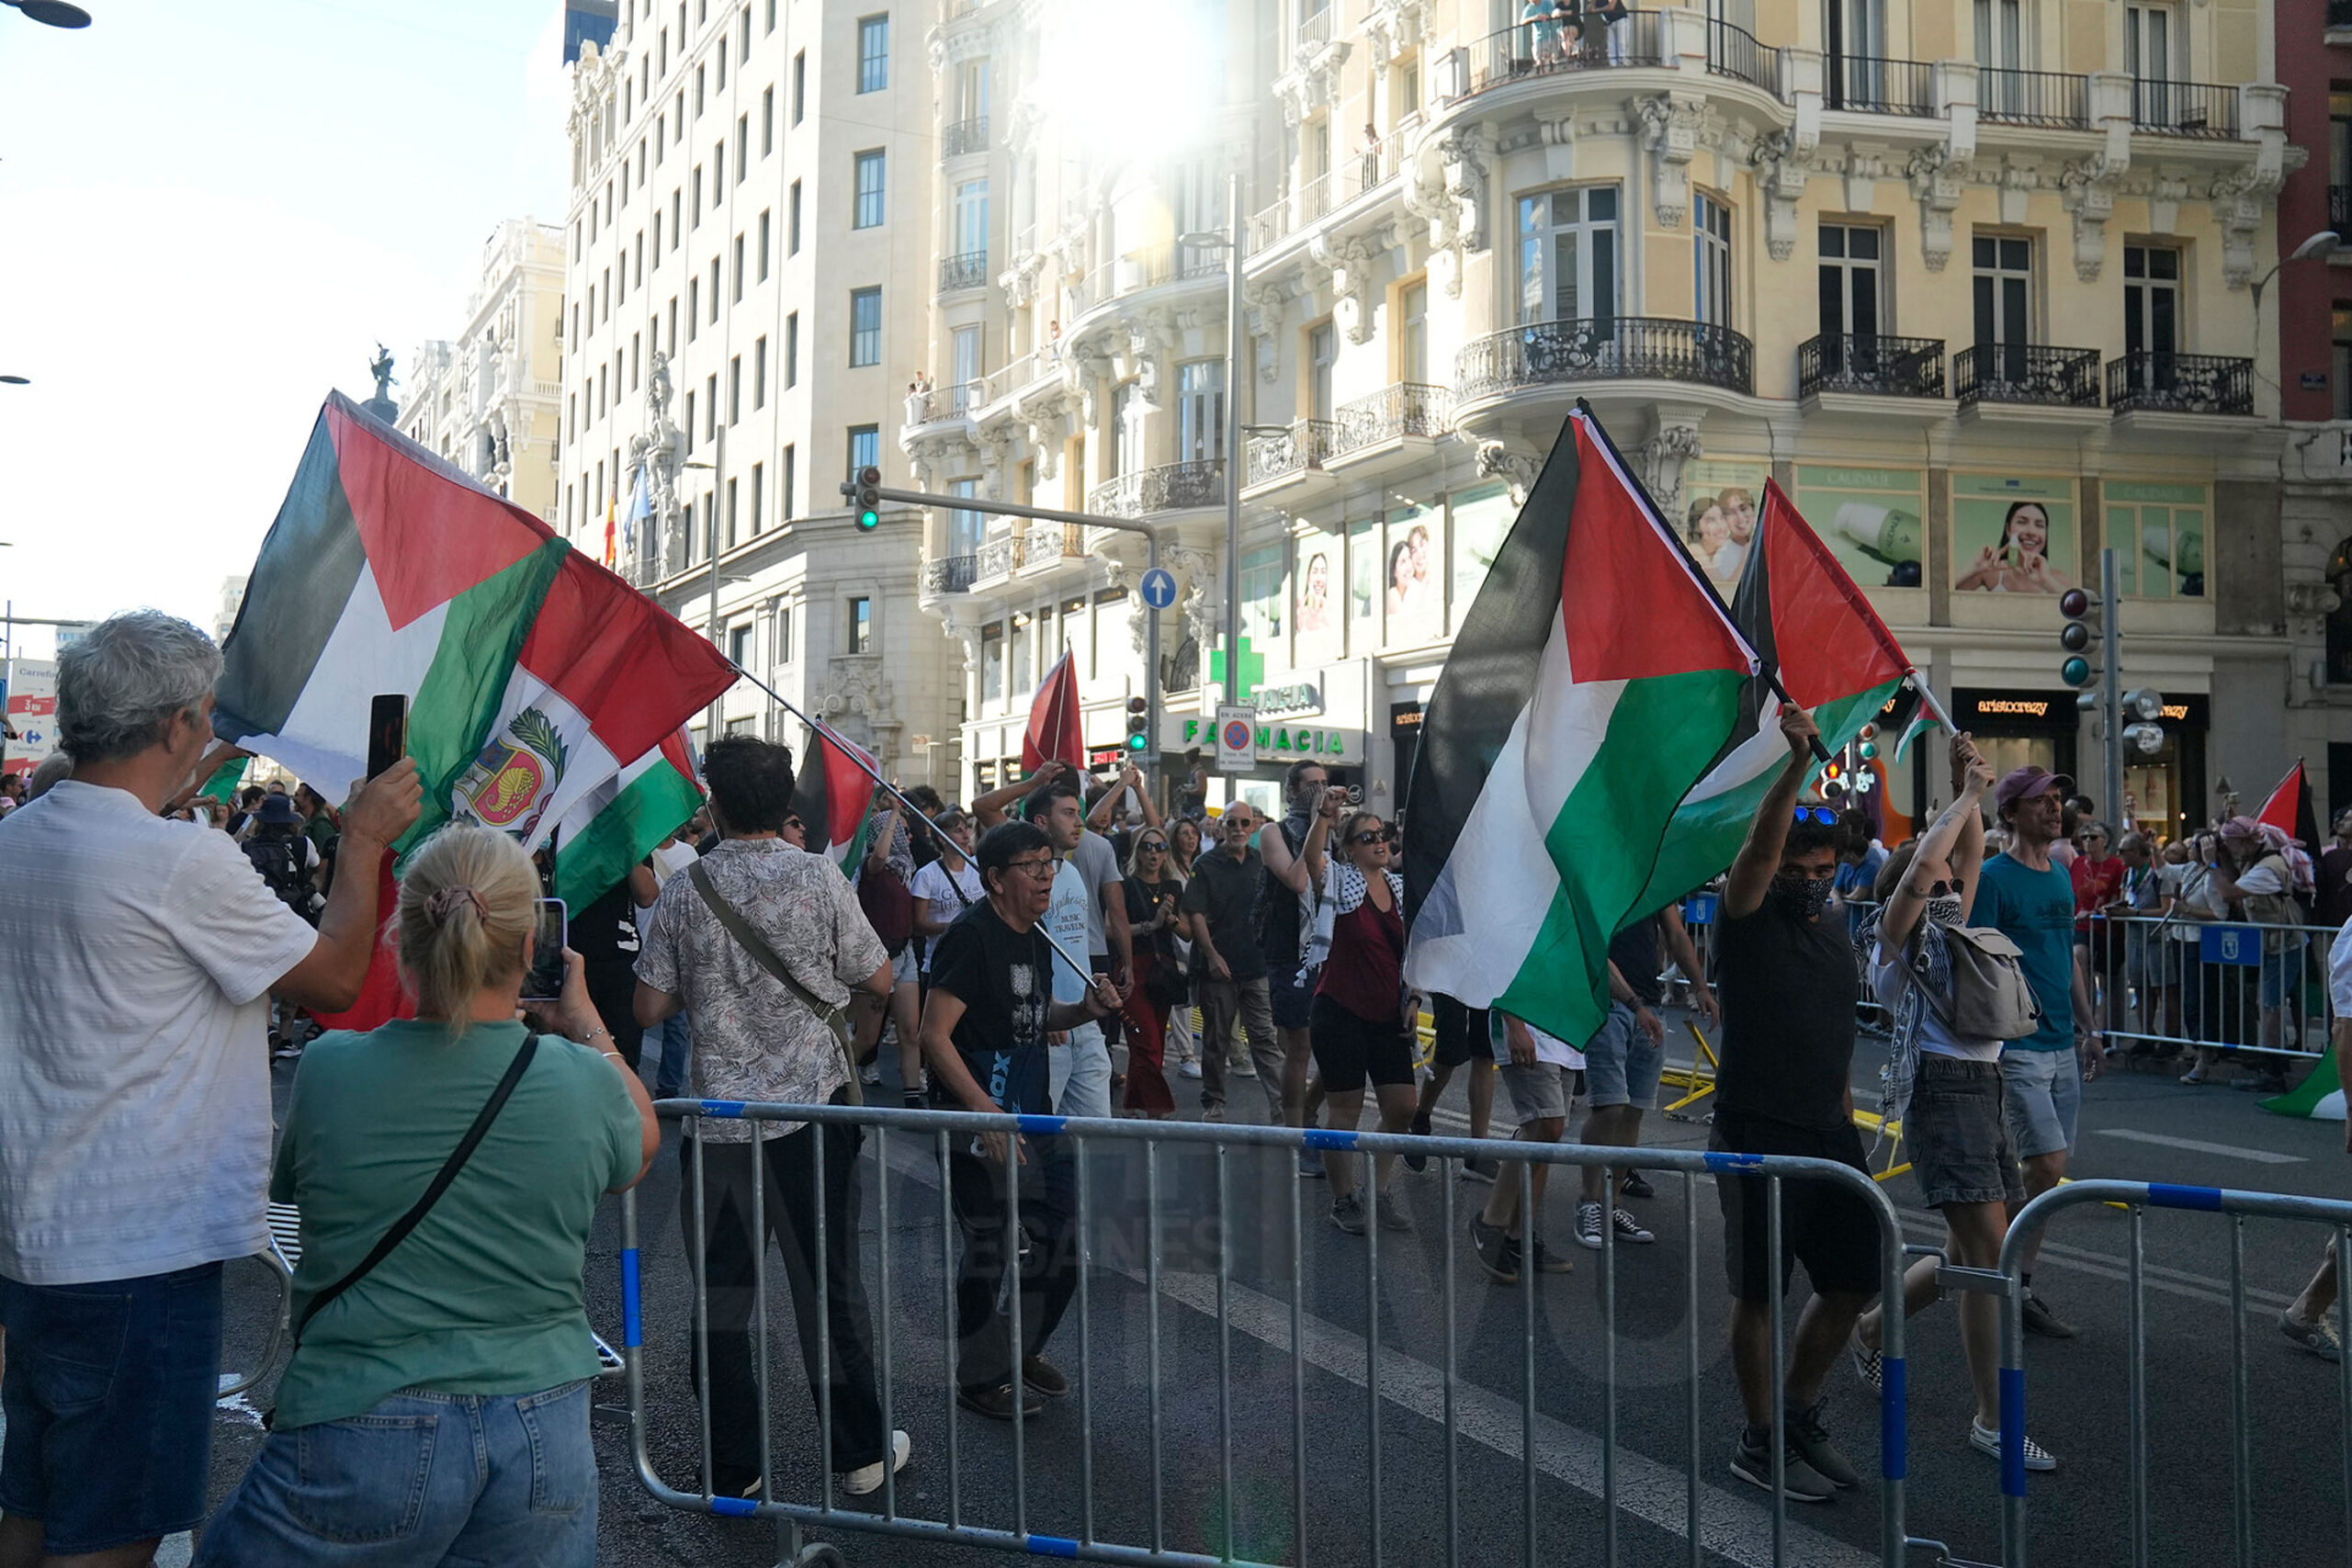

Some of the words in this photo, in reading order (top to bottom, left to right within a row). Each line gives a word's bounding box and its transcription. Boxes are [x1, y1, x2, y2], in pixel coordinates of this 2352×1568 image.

[19, 668, 56, 678] Carrefo
[25, 699, 31, 711] 3
[1978, 699, 2049, 716] aristocrazy
[1186, 719, 1344, 755] FAMACIA
